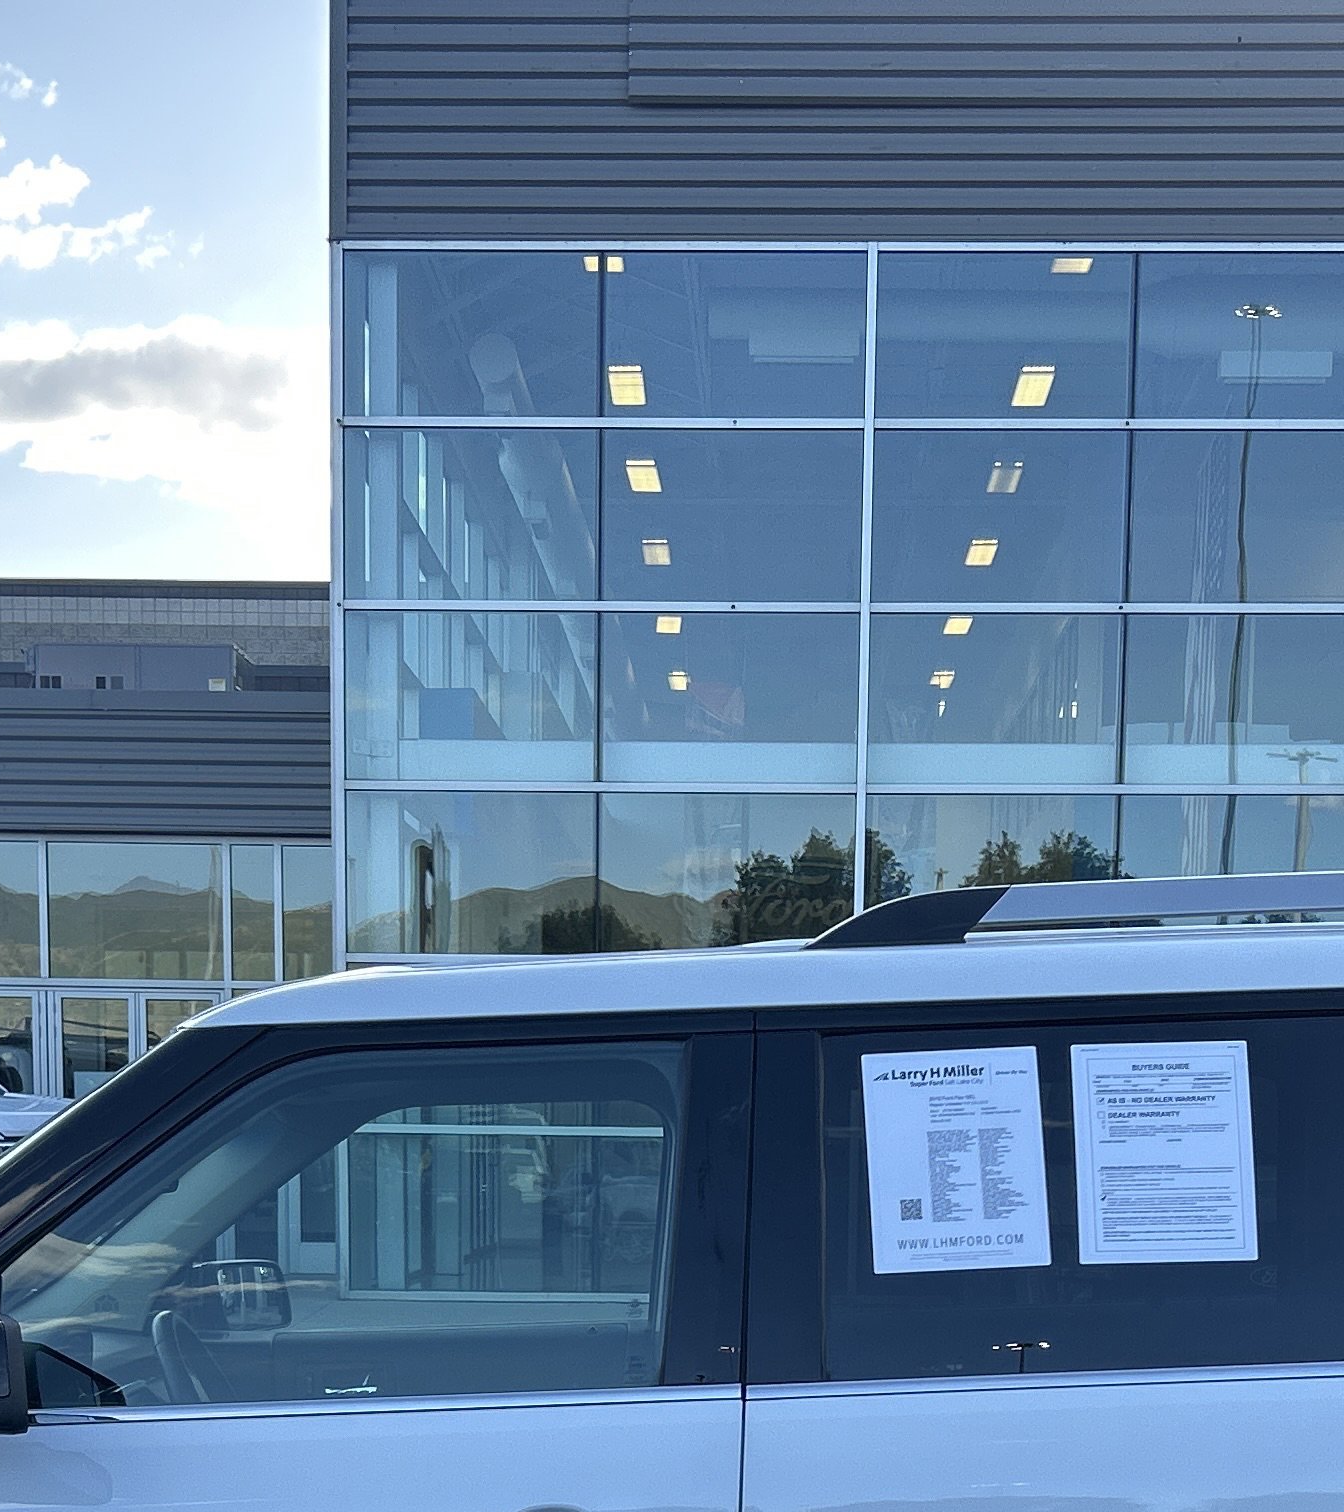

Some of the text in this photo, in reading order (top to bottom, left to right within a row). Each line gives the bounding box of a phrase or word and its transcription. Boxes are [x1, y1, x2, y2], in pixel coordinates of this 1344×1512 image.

[1131, 1062, 1190, 1071] BUYERS GUIDE
[891, 1069, 928, 1081] Larry
[930, 1067, 941, 1078] H
[943, 1064, 985, 1078] Miller
[1131, 1096, 1142, 1104] NO
[1174, 1095, 1216, 1103] WARRANTY
[1107, 1110, 1180, 1119] DEALER WARRANTY
[897, 1233, 1024, 1250] WWW.LHMFORD.COM
